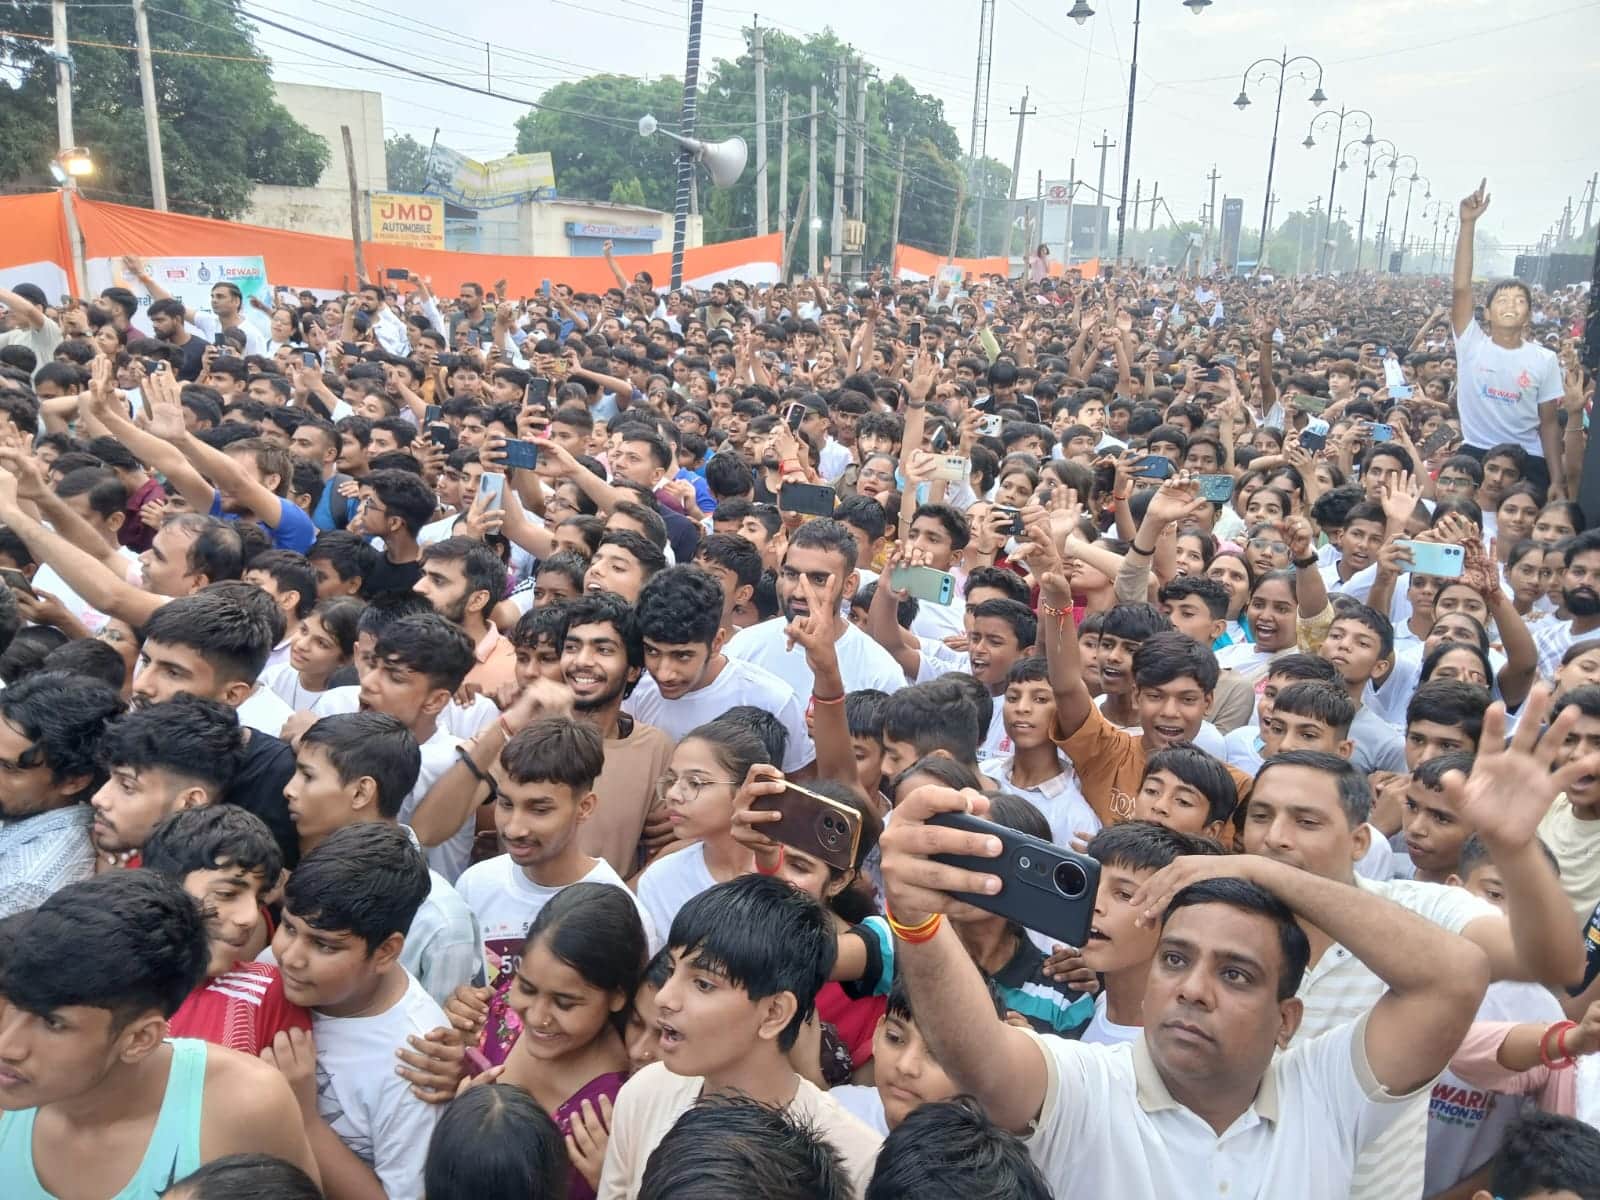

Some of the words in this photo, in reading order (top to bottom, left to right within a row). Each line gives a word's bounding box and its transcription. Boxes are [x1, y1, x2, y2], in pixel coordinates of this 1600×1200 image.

[380, 203, 433, 221] JMD
[382, 223, 432, 233] AUTOMOBILE
[1431, 1083, 1489, 1108] WARI
